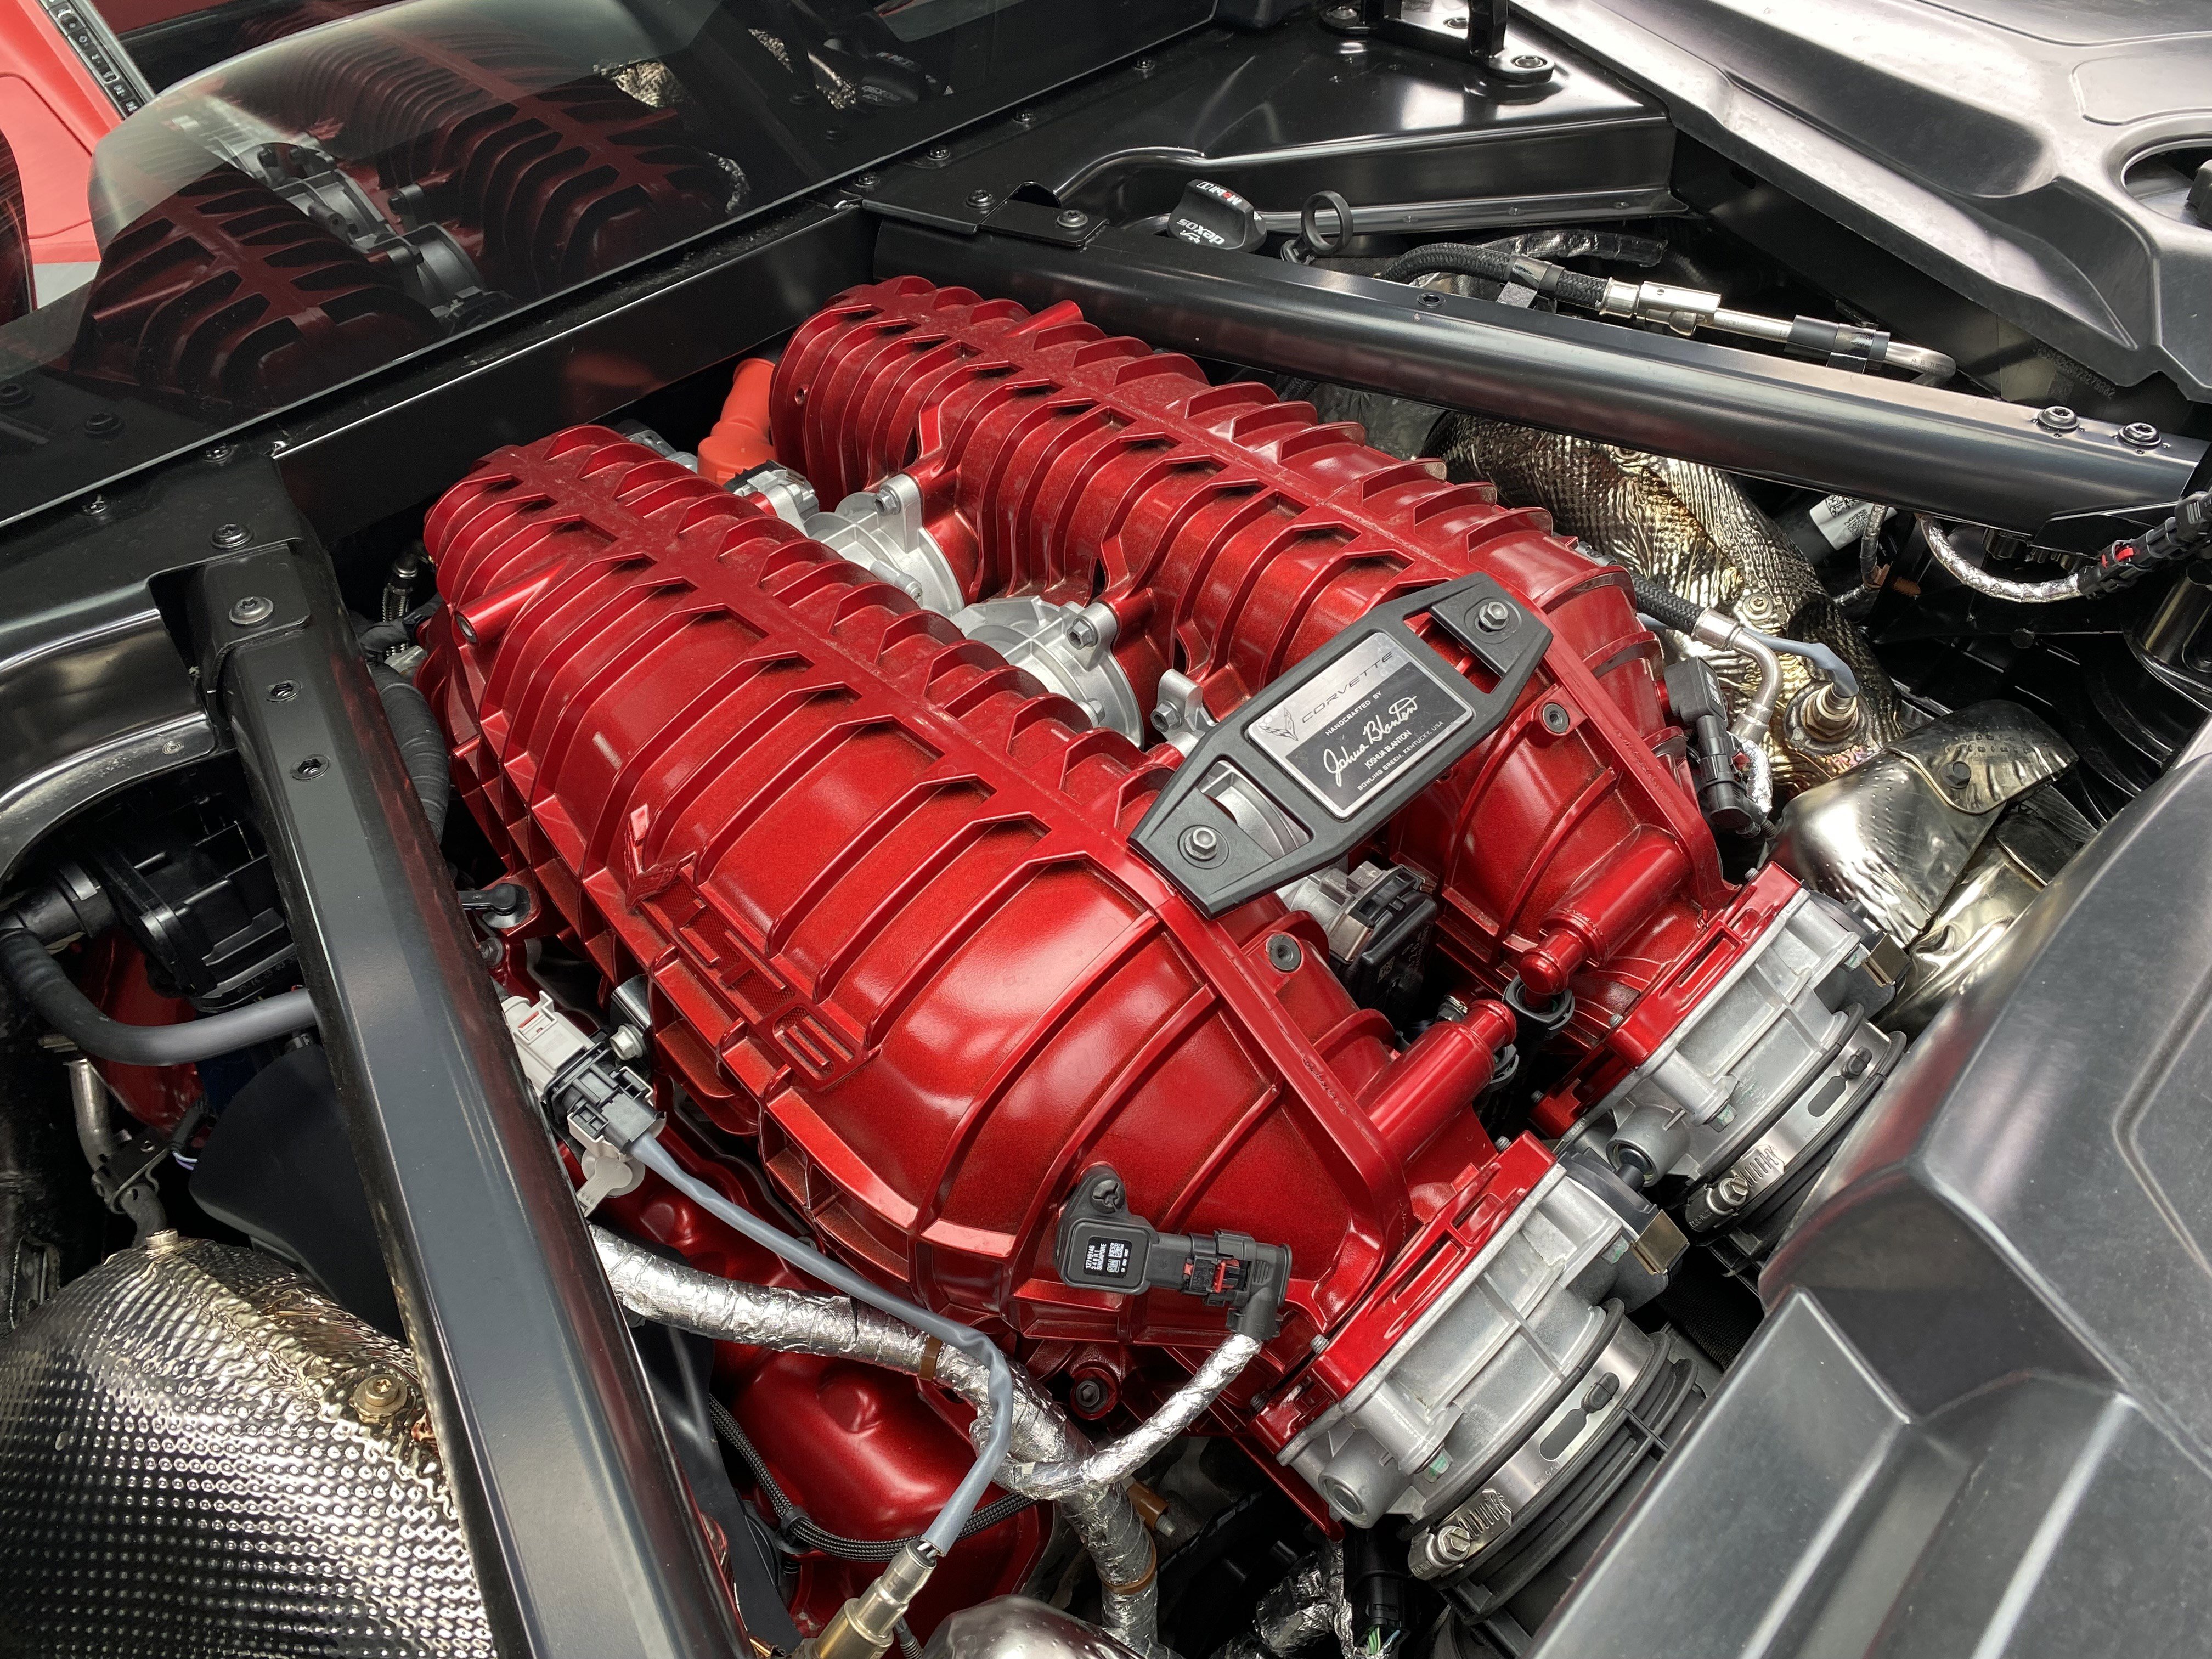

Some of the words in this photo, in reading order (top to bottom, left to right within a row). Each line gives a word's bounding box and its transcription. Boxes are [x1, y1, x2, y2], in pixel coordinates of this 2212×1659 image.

[1209, 186, 1243, 205] Mobil
[1176, 218, 1225, 244] dexos
[1302, 651, 1392, 723] CORVETTE
[1325, 699, 1372, 736] HANDCRAFTED
[1373, 690, 1382, 699] BY
[1357, 769, 1384, 791] BOWLING
[1431, 721, 1444, 731] USA
[1364, 749, 1387, 770] JOSHUA
[1384, 730, 1412, 753] BLANTON
[1097, 1243, 1107, 1271] SINGAPORE
